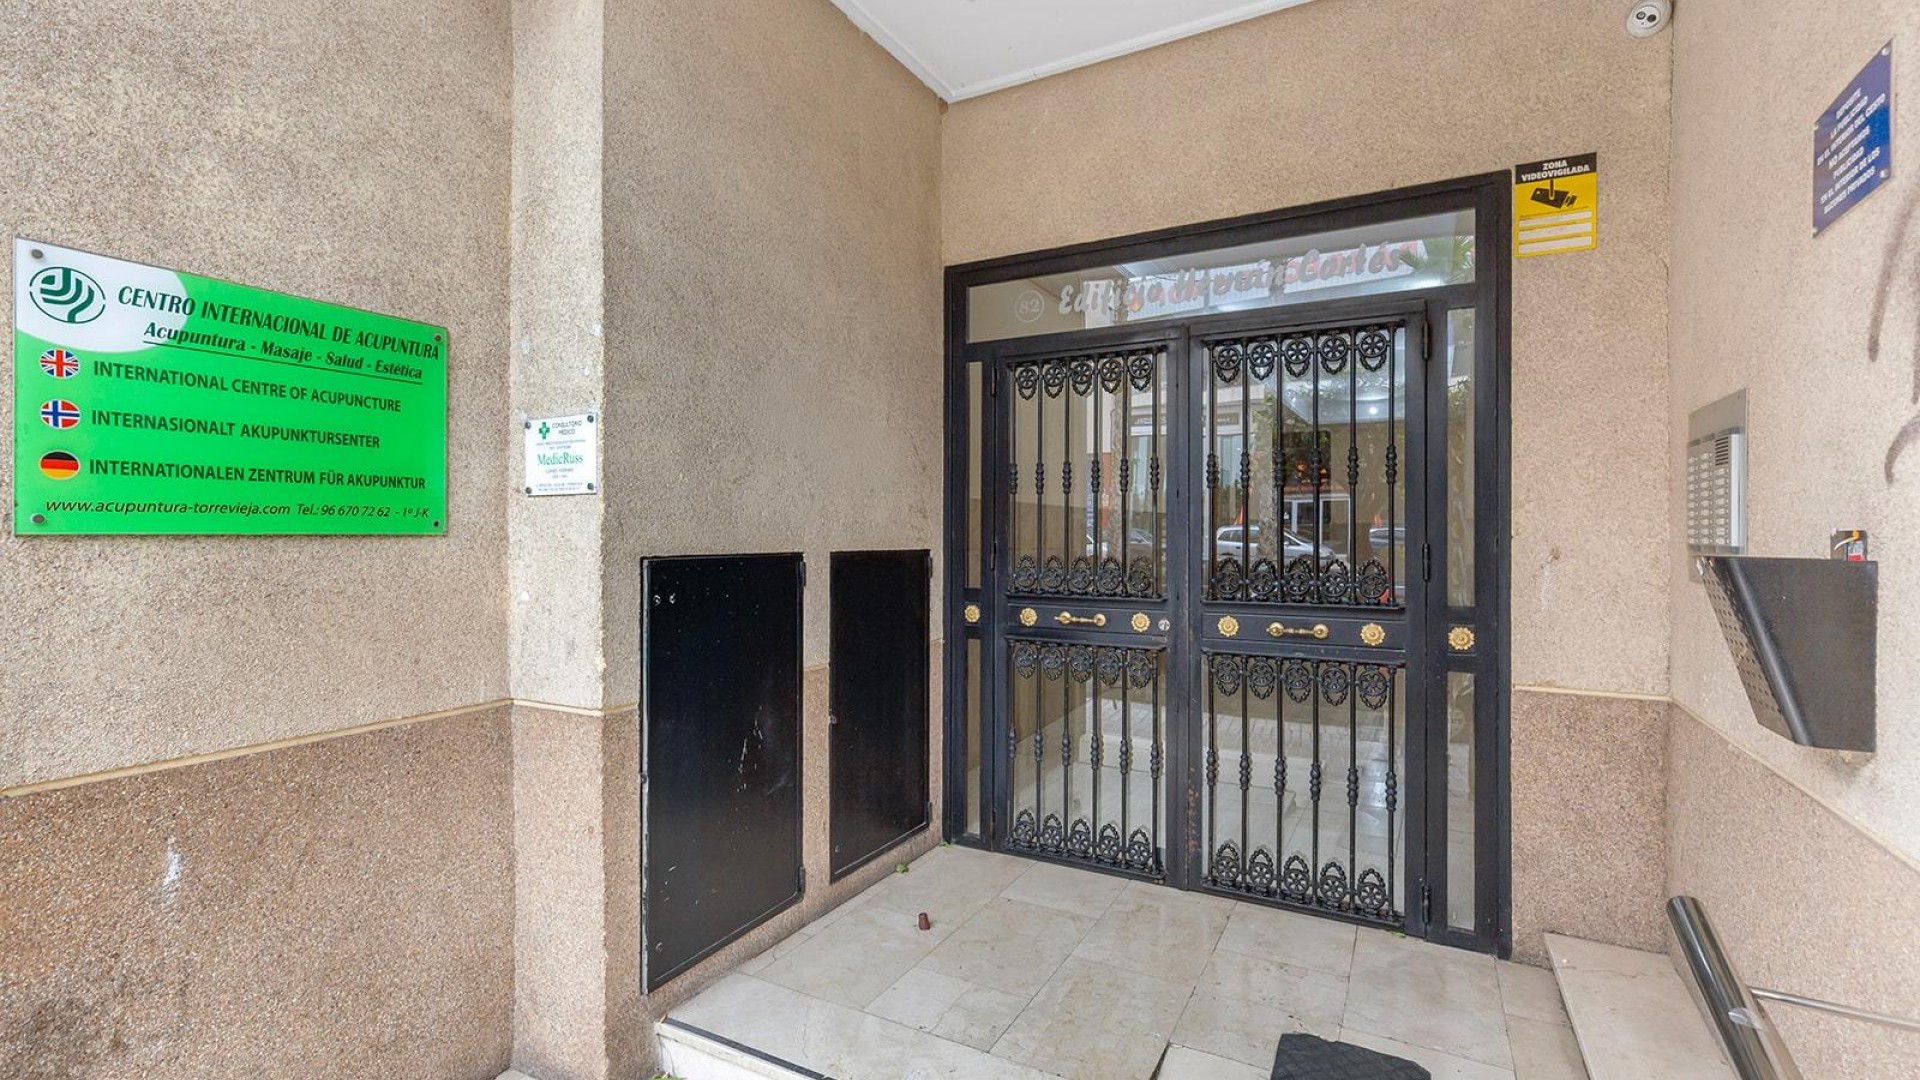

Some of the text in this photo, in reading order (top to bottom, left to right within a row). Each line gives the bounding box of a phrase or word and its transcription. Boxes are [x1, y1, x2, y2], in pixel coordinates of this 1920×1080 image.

[1543, 160, 1567, 170] ZONA
[1829, 155, 1837, 169] NO
[1521, 164, 1590, 181] VIDEOVIGILADA
[1018, 299, 1040, 315] 82
[118, 286, 438, 360] CENTRO INTERNACIONAL DE ACUPUNTURA
[144, 322, 246, 351] Acupuntura
[261, 341, 312, 363] Masaje
[326, 351, 363, 369] Salud
[375, 360, 422, 379] Estética
[94, 361, 401, 412] INTERNATIONAL CENTRE OF ACUPUNCTURE
[92, 410, 380, 448] INTERNASIONALT AKUPUNKTURSENTER
[552, 420, 582, 428] CONSULTORIO
[537, 451, 584, 466] MedicRuss
[90, 459, 425, 489] INTERNATIONALEN ZENTRUM FÜR AKUPUNKTUR
[46, 501, 290, 517] www.acupuntura-torrevieja.com
[321, 504, 336, 516] 96
[338, 505, 359, 516] 670
